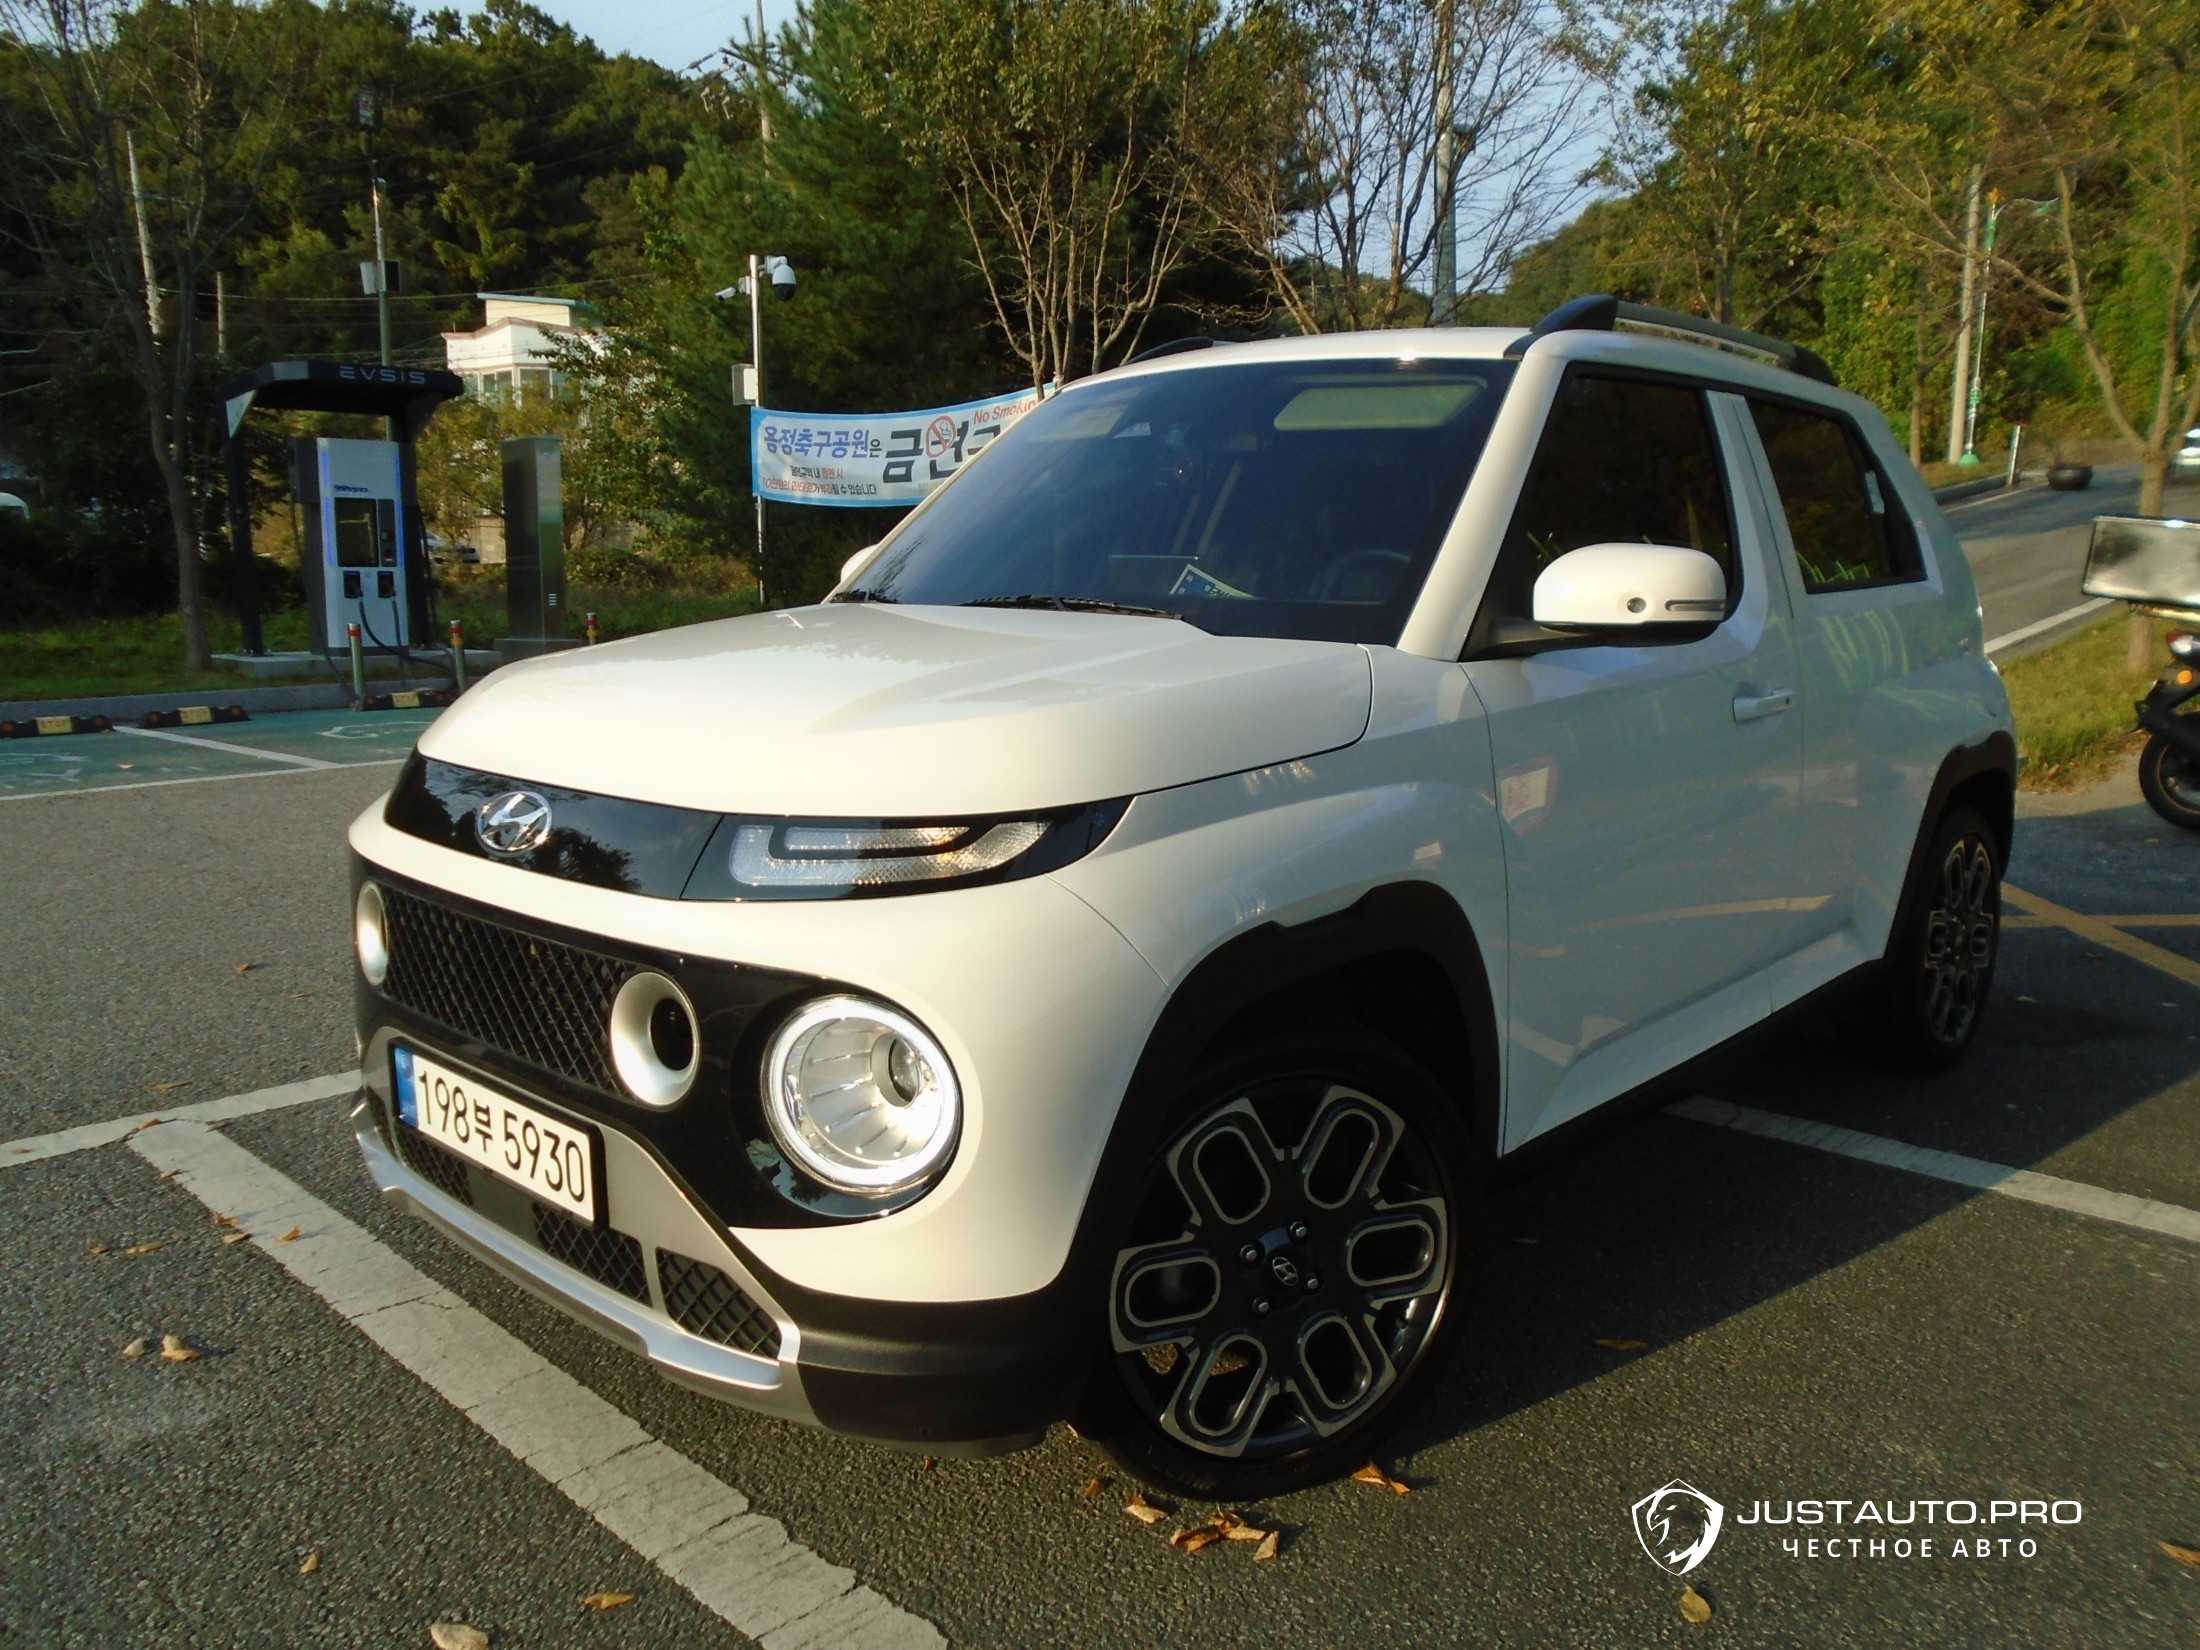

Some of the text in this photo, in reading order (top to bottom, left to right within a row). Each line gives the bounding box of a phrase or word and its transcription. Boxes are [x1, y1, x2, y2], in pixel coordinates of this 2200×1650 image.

[339, 365, 425, 385] EVSIS
[973, 399, 1039, 425] No Smokin
[847, 484, 877, 496] 있습니다
[418, 1070, 586, 1203] 198부 5930
